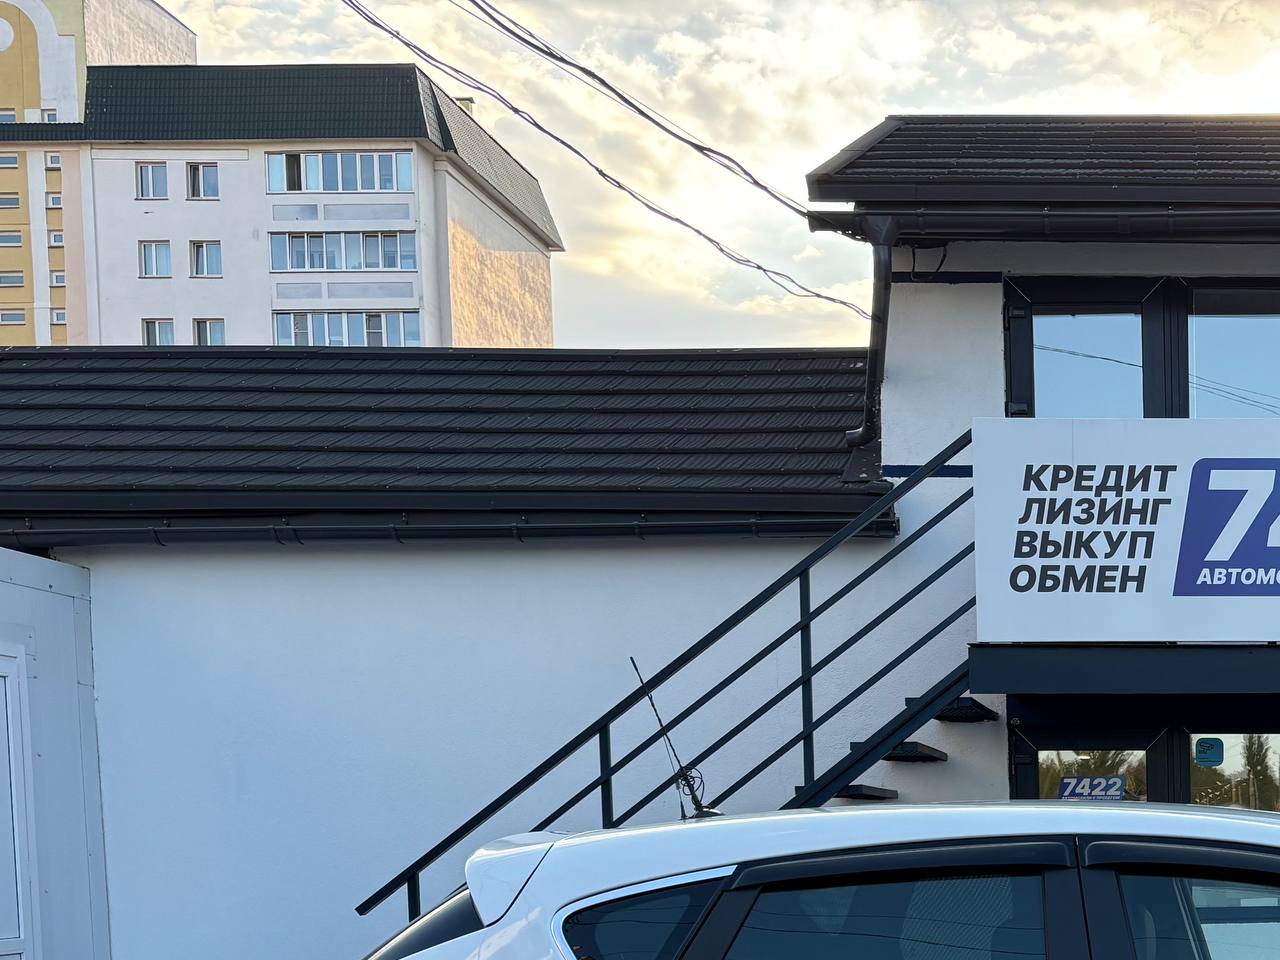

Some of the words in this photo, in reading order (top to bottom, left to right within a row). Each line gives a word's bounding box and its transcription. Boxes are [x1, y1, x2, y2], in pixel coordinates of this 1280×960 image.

[1022, 464, 1177, 497] КРЕДИТ
[1018, 498, 1172, 525] ЛИЗИНГ
[1013, 530, 1155, 559] ВЫКУП
[1009, 564, 1147, 593] ОБМЕН
[1063, 778, 1121, 796] 7422
